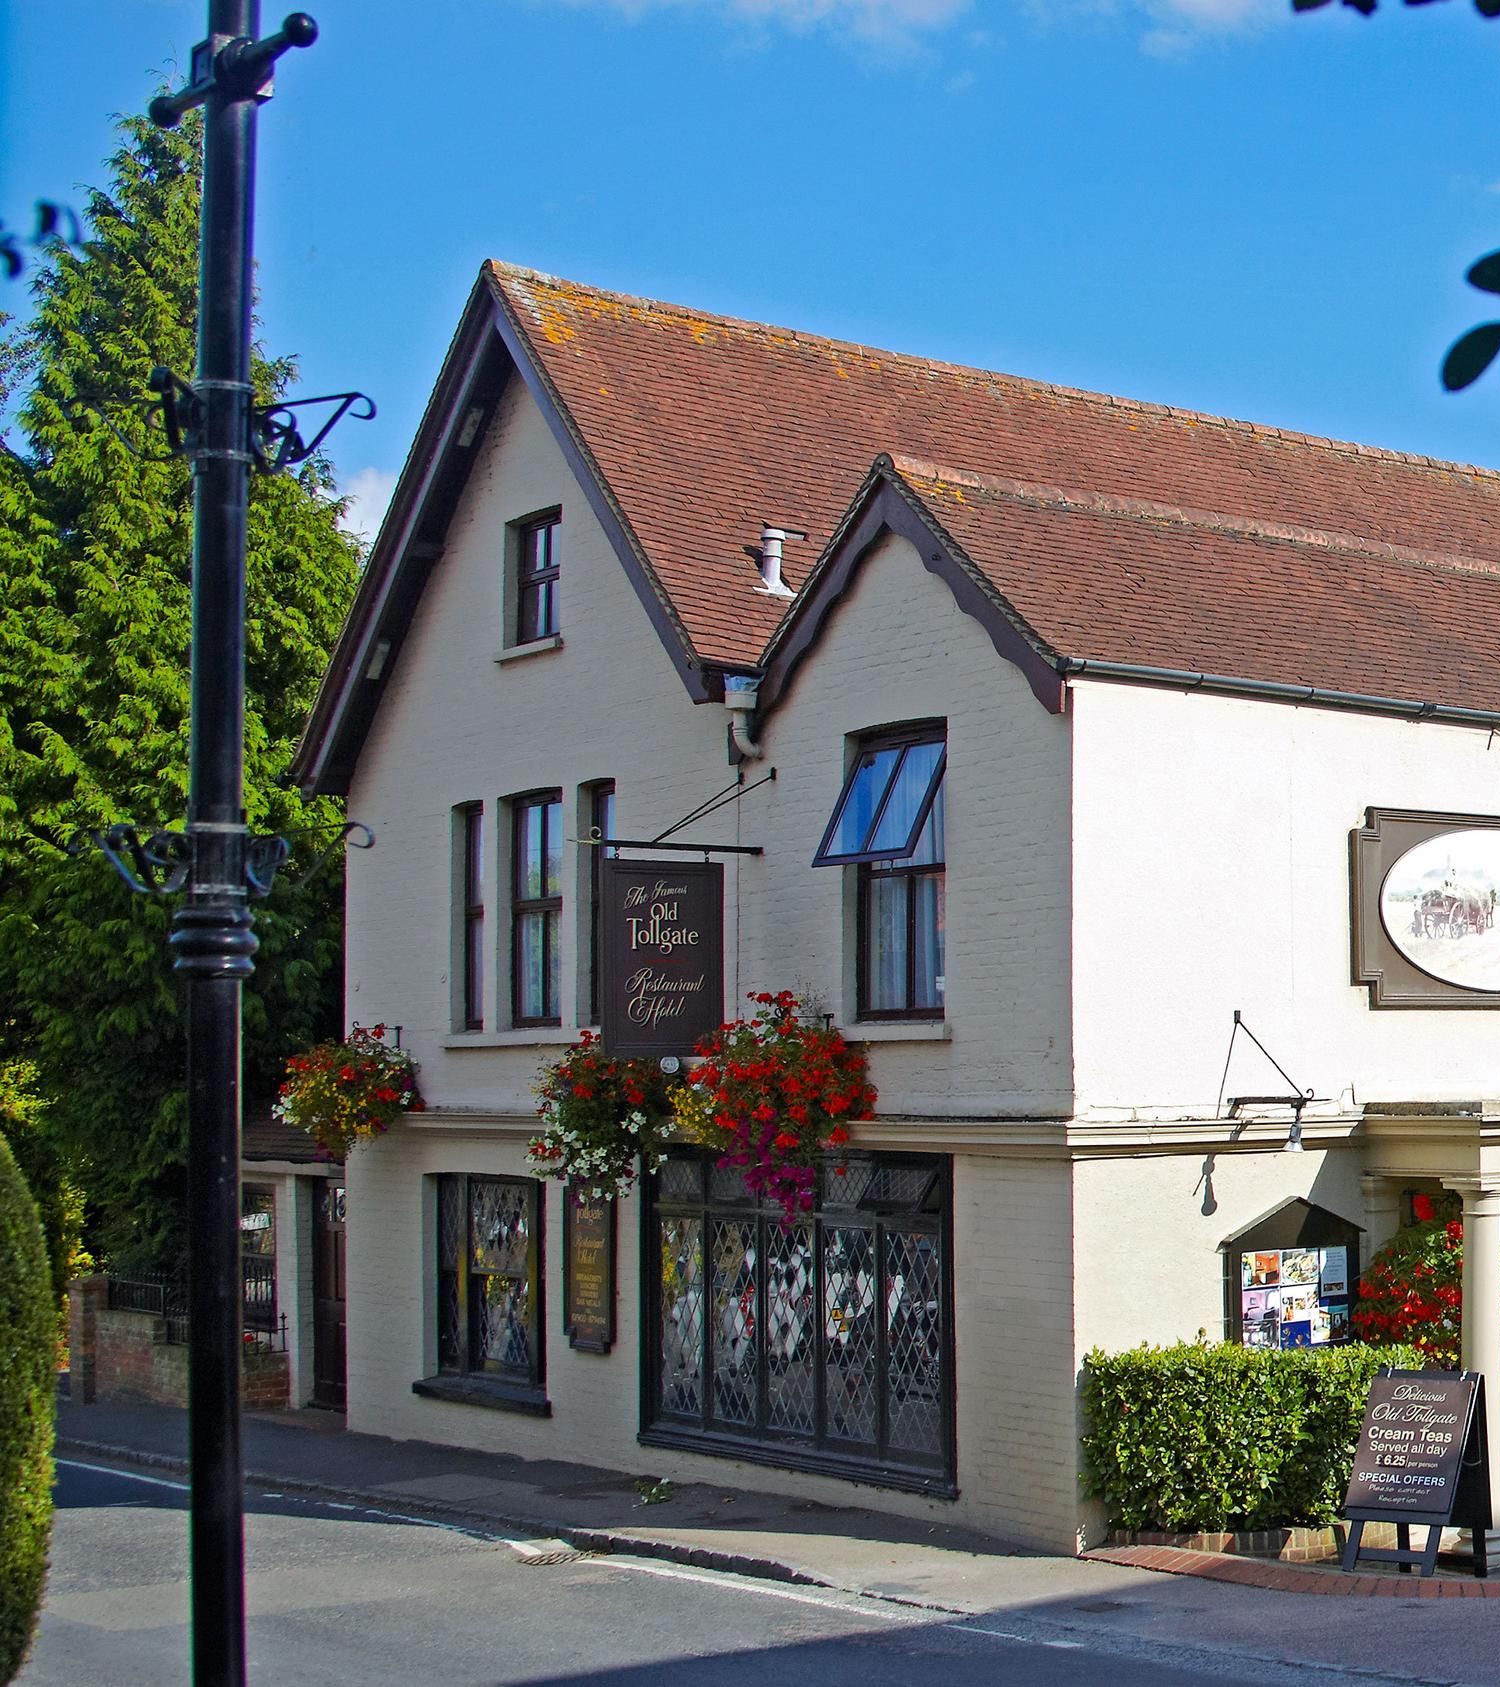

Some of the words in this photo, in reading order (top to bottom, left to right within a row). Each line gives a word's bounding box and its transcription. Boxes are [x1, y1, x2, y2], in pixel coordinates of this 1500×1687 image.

[624, 886, 648, 909] The
[650, 902, 678, 920] Old
[626, 914, 699, 955] Tollgate
[625, 967, 704, 1001] Restaurant
[1391, 1384, 1447, 1402] Delicious
[1372, 1403, 1403, 1421] Old
[1402, 1403, 1458, 1429] Tollgate
[1368, 1426, 1415, 1440] Cream
[1420, 1428, 1453, 1443] Teas
[1369, 1440, 1409, 1453] Served
[1411, 1443, 1424, 1454] all
[1426, 1444, 1448, 1457] day
[1358, 1472, 1401, 1484] SPECIAL
[1403, 1475, 1446, 1487] OFFERS
[1368, 1484, 1395, 1493] Please
